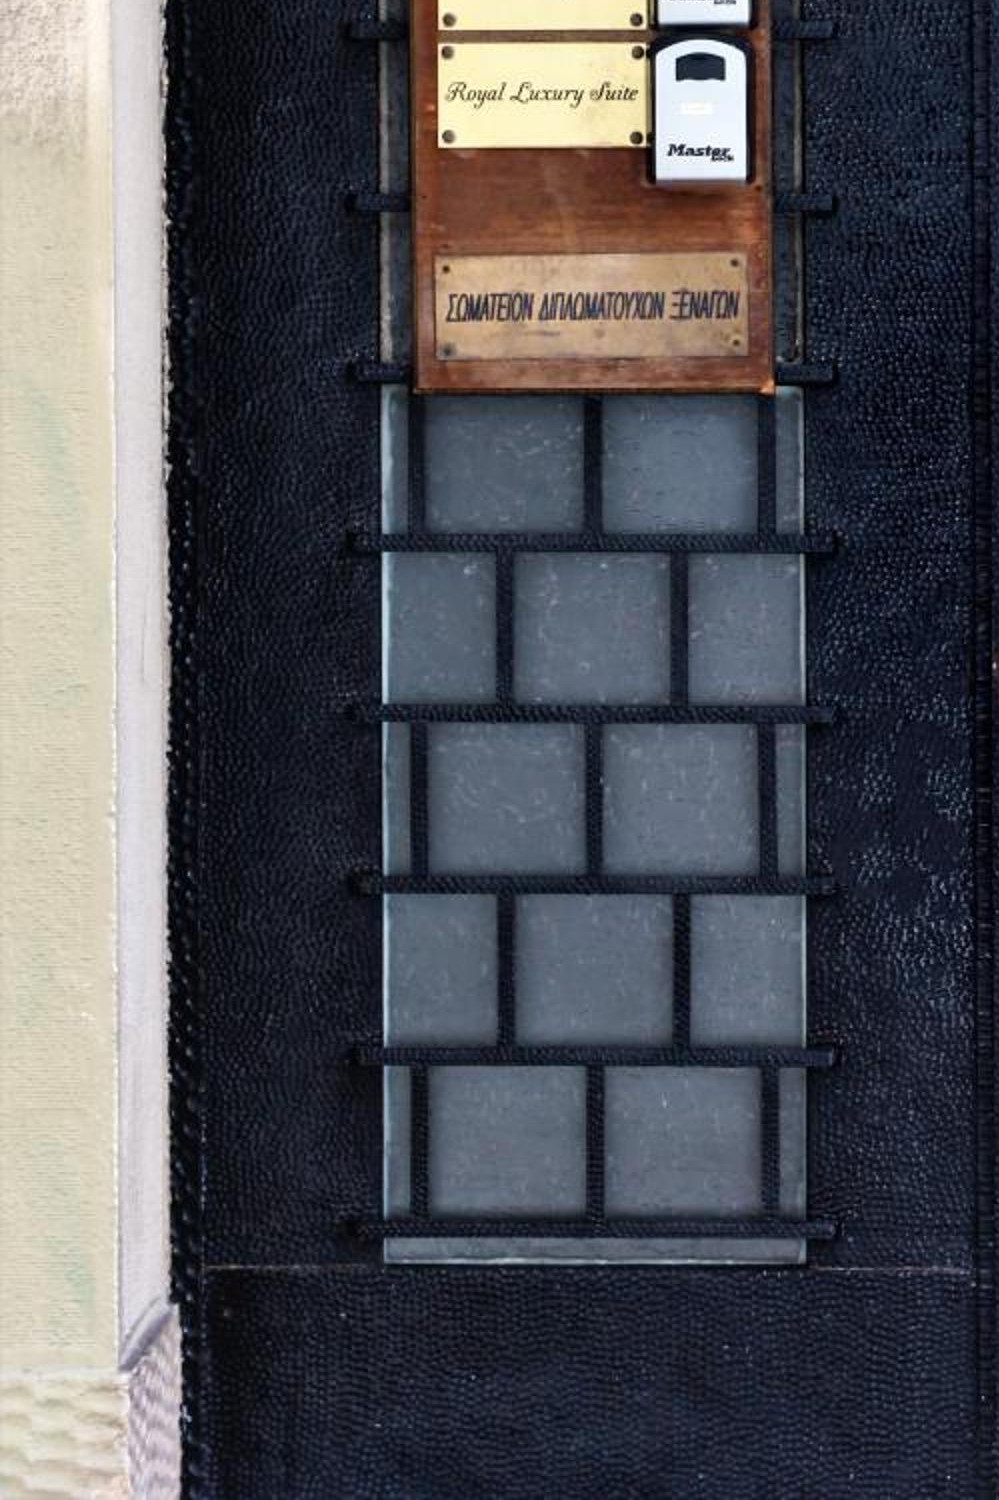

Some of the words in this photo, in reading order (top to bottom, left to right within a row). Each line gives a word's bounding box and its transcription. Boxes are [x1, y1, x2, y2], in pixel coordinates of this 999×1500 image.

[445, 81, 507, 108] Royal
[509, 81, 585, 108] Luxury
[589, 81, 639, 101] Suite
[667, 143, 731, 157] Master
[446, 292, 534, 322] ΣΩΜΑΤΕΙΟΝ
[538, 291, 665, 321] ΔΙΠΛΩΜΑΤΟΥΧΩΝ
[669, 290, 740, 320] ΞΕΝΑΓΩΝ
